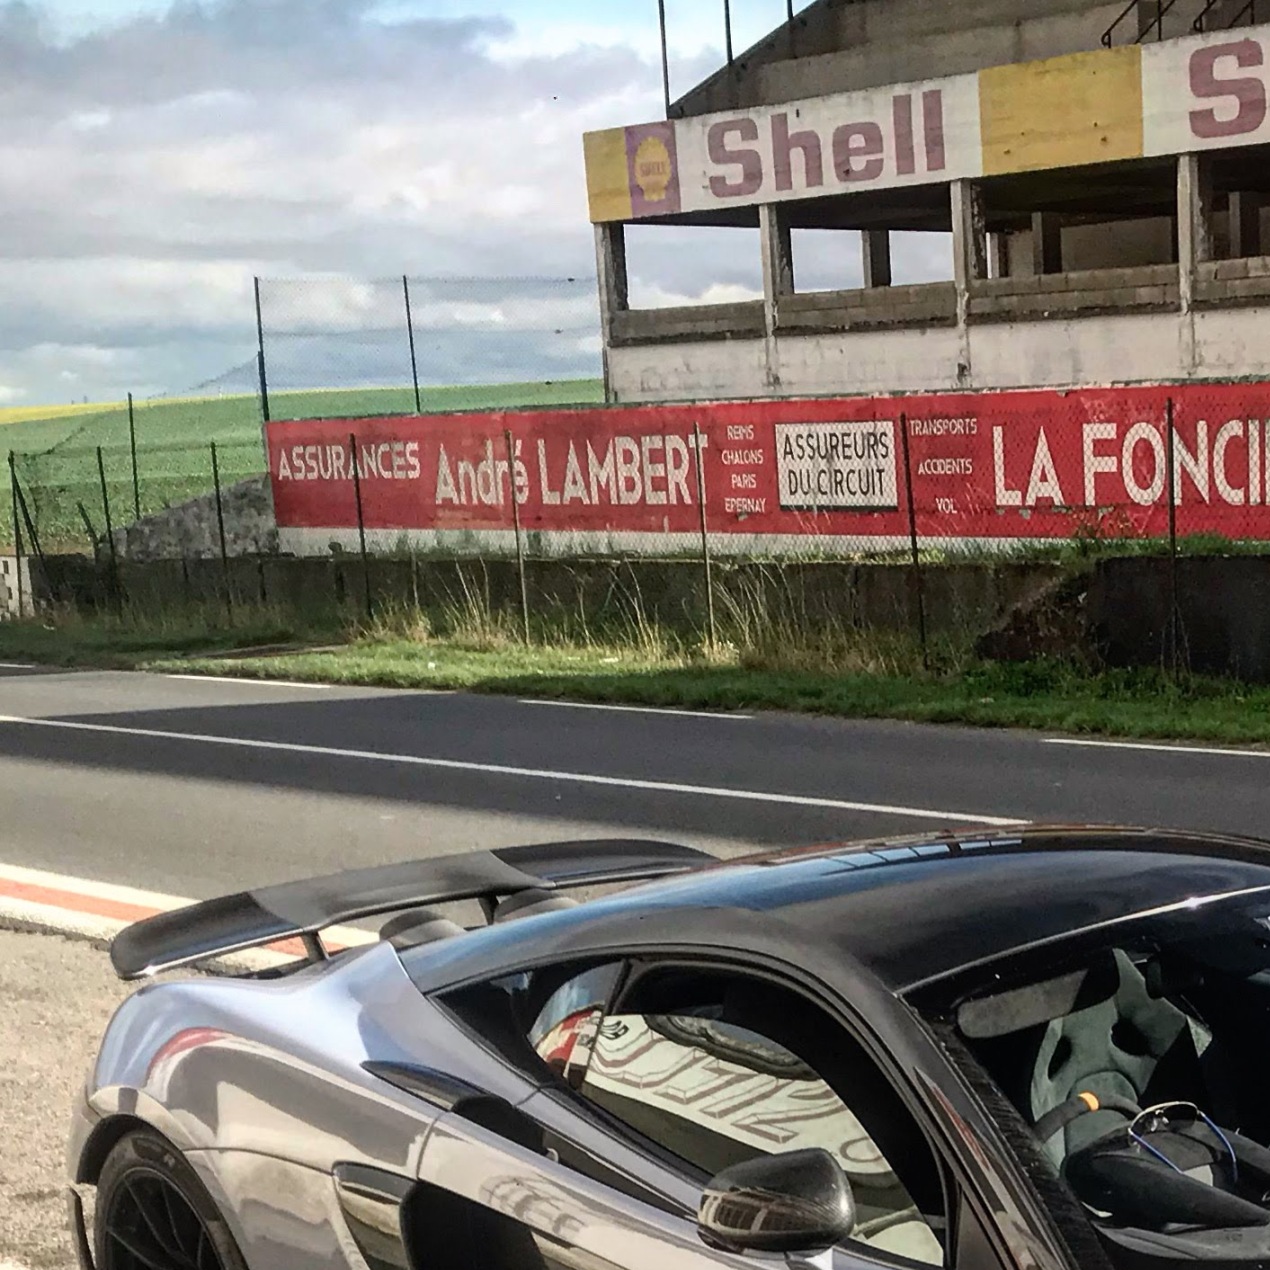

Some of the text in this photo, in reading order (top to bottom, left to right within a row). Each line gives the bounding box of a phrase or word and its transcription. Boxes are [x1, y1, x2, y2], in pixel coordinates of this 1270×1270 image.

[707, 89, 946, 198] Shell
[727, 424, 754, 440] REIMS
[909, 418, 977, 436] TRANSPORTS
[783, 431, 889, 460] ASSUREURS
[721, 449, 763, 465] CHALONS
[278, 433, 708, 506] ASSURANCES André LAMBERT
[918, 458, 972, 475] ACCIDENTS
[993, 426, 1065, 506] LA
[731, 473, 756, 489] PARIS
[788, 468, 885, 496] DU CIRCUIT
[725, 497, 766, 513] EPERNAY
[936, 498, 957, 514] VOL
